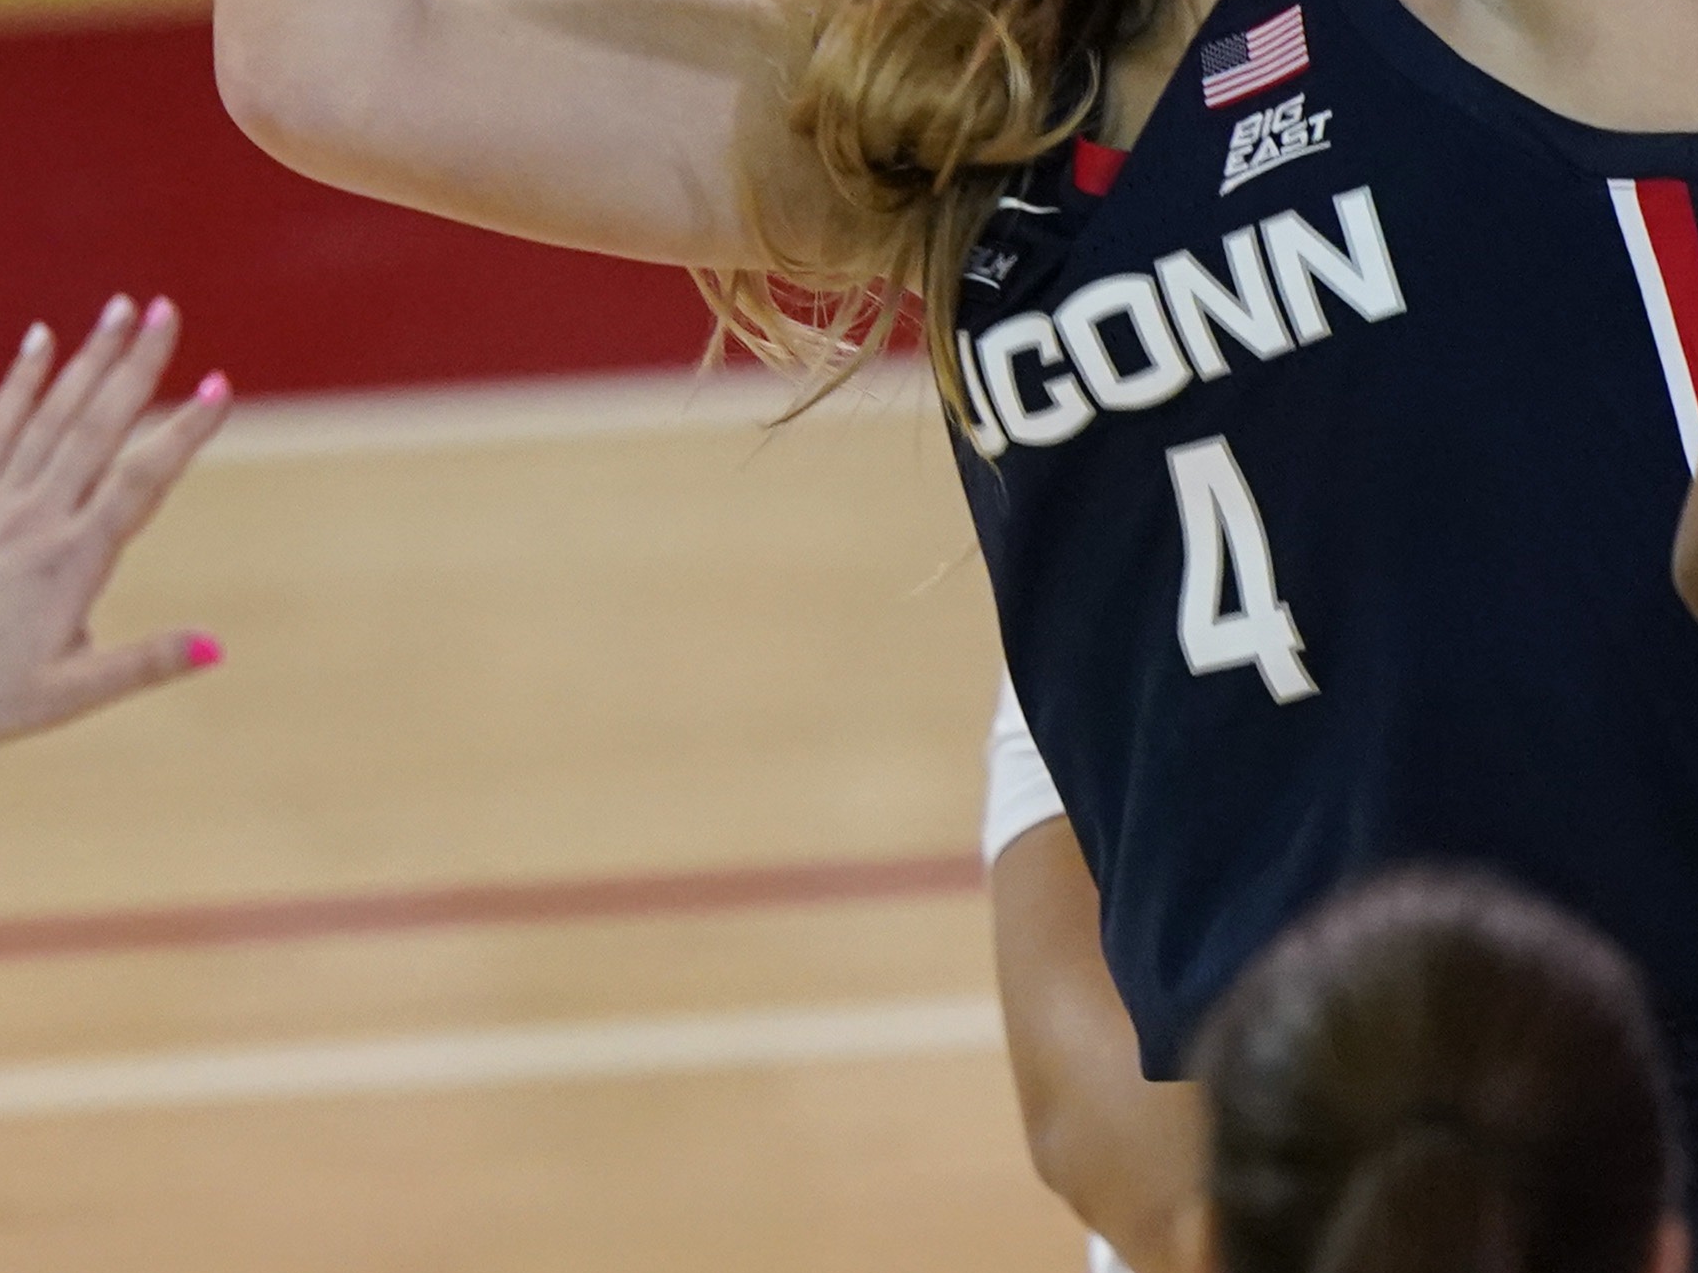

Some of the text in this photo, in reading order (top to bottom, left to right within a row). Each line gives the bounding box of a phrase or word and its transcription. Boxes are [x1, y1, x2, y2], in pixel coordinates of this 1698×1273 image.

[1223, 109, 1334, 179] EAST
[1229, 92, 1306, 149] BIG
[1165, 433, 1322, 706] 4
